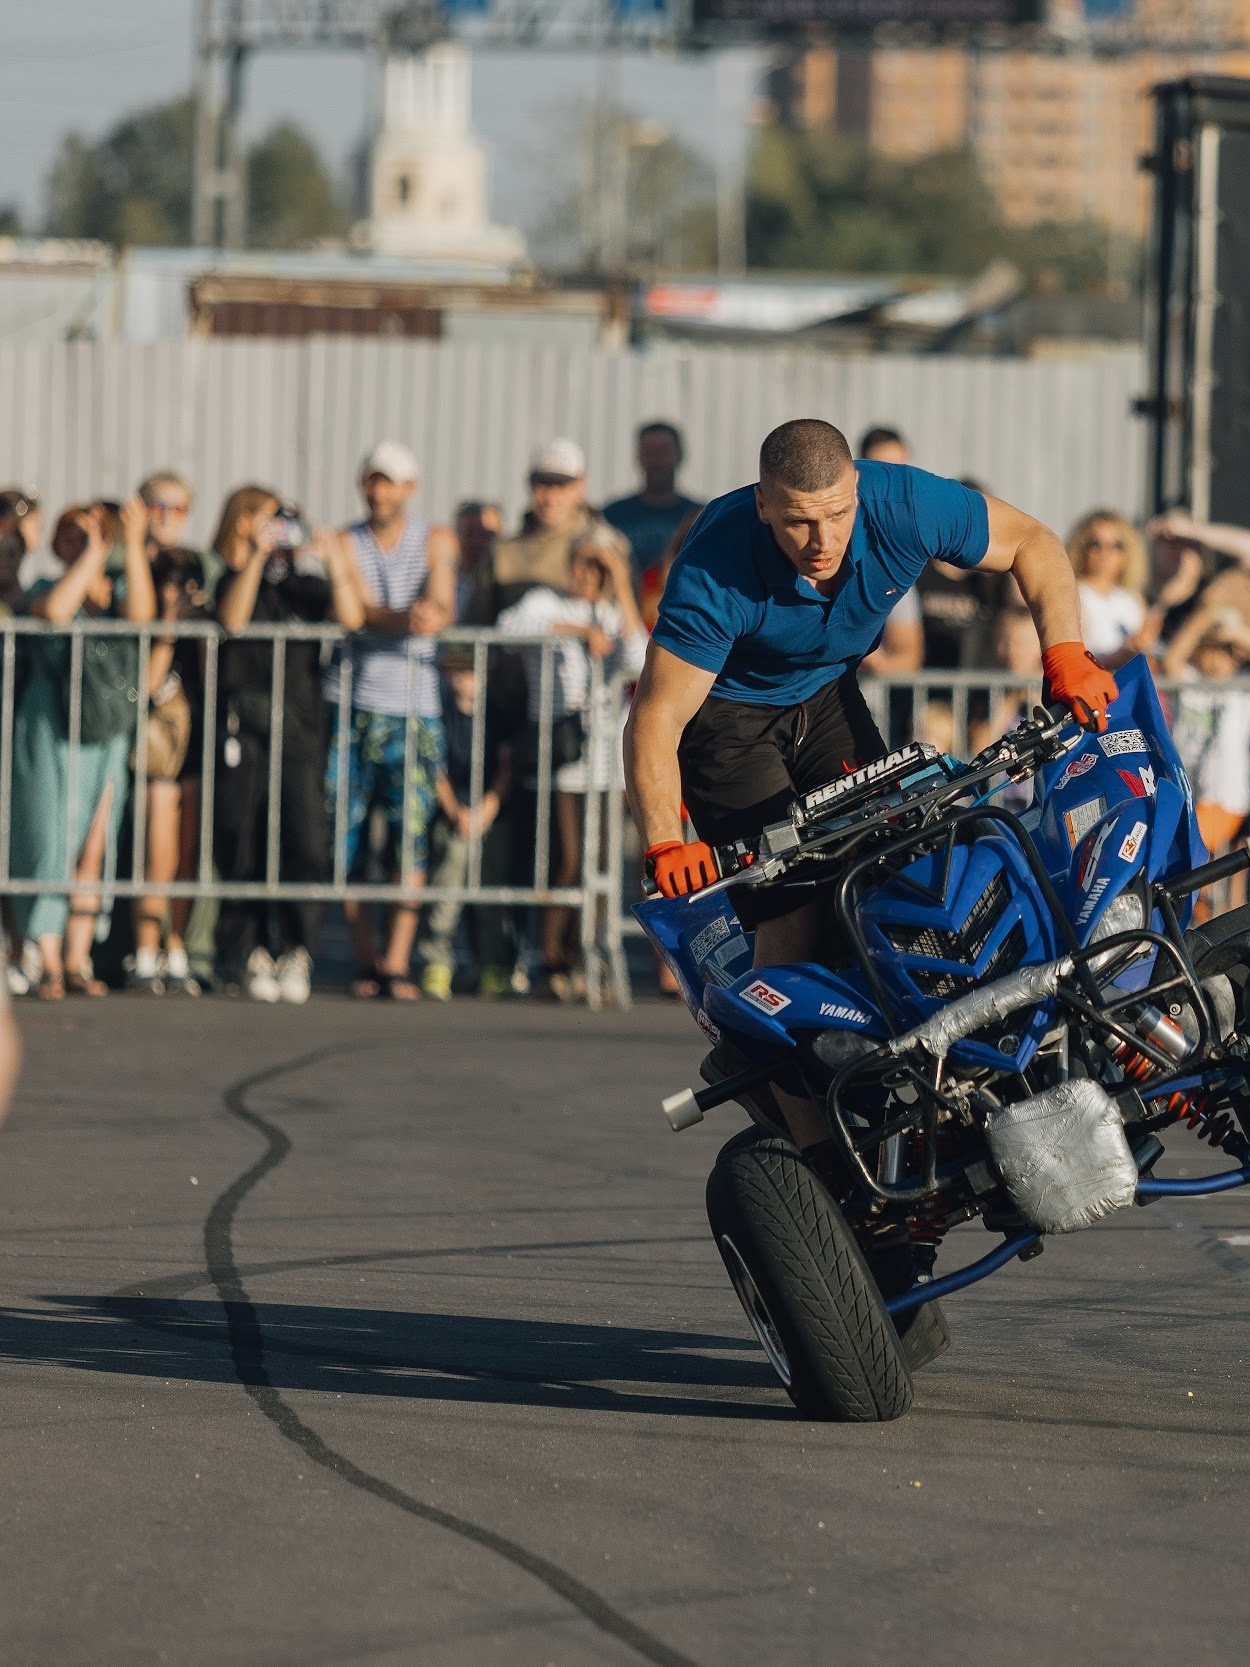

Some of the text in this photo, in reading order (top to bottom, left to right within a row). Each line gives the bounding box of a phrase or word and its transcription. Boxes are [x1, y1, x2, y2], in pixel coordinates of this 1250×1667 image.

[805, 745, 919, 809] RENTHAL
[1075, 877, 1111, 926] YAMAHA
[750, 984, 785, 1008] RS
[818, 1002, 873, 1025] YAMAHA
